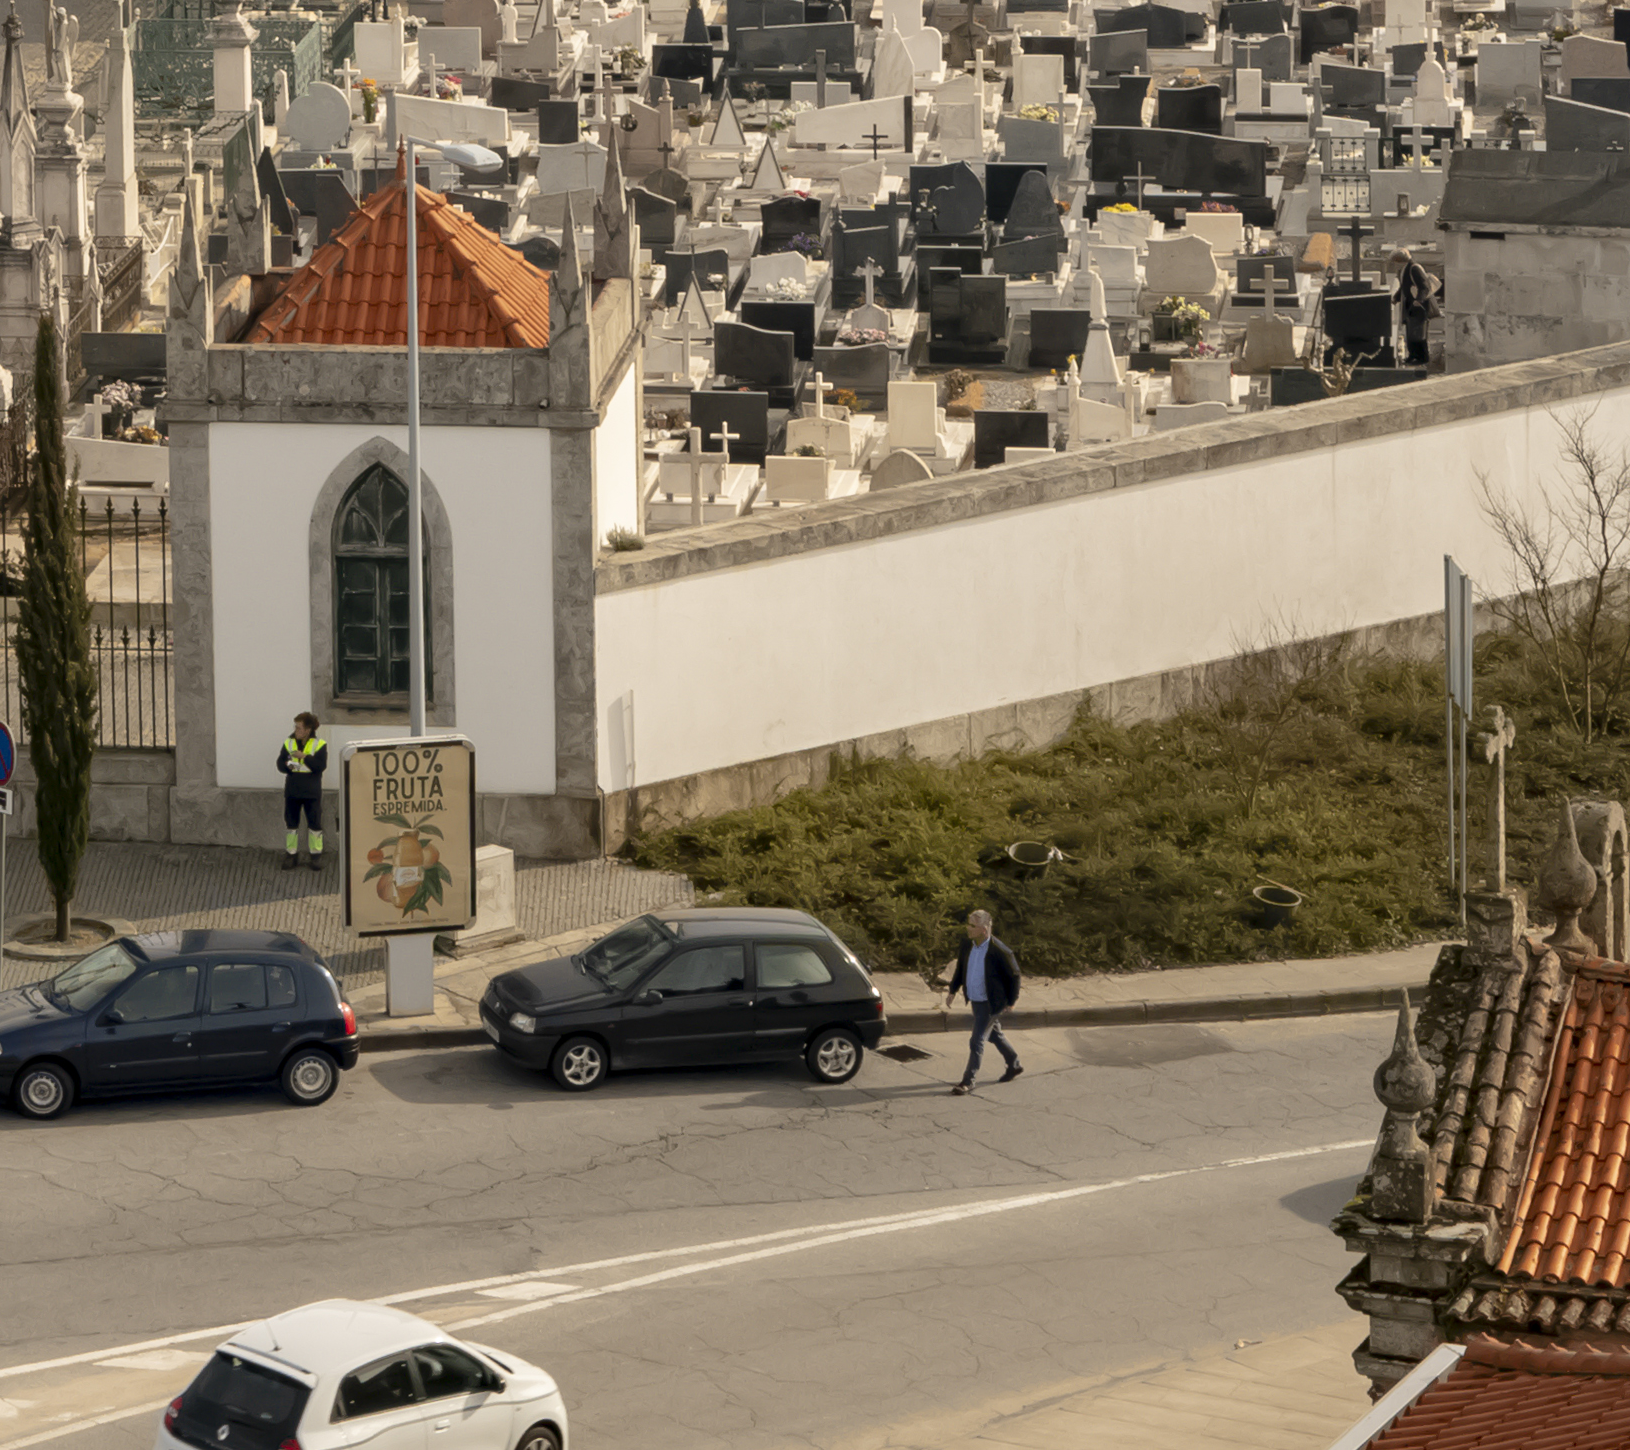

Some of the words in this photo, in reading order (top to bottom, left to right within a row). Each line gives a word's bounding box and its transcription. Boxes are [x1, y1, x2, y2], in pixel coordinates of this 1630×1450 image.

[372, 748, 444, 778] 100%
[372, 775, 444, 803] FRUTA
[372, 799, 448, 816] ESPREMIDA.
